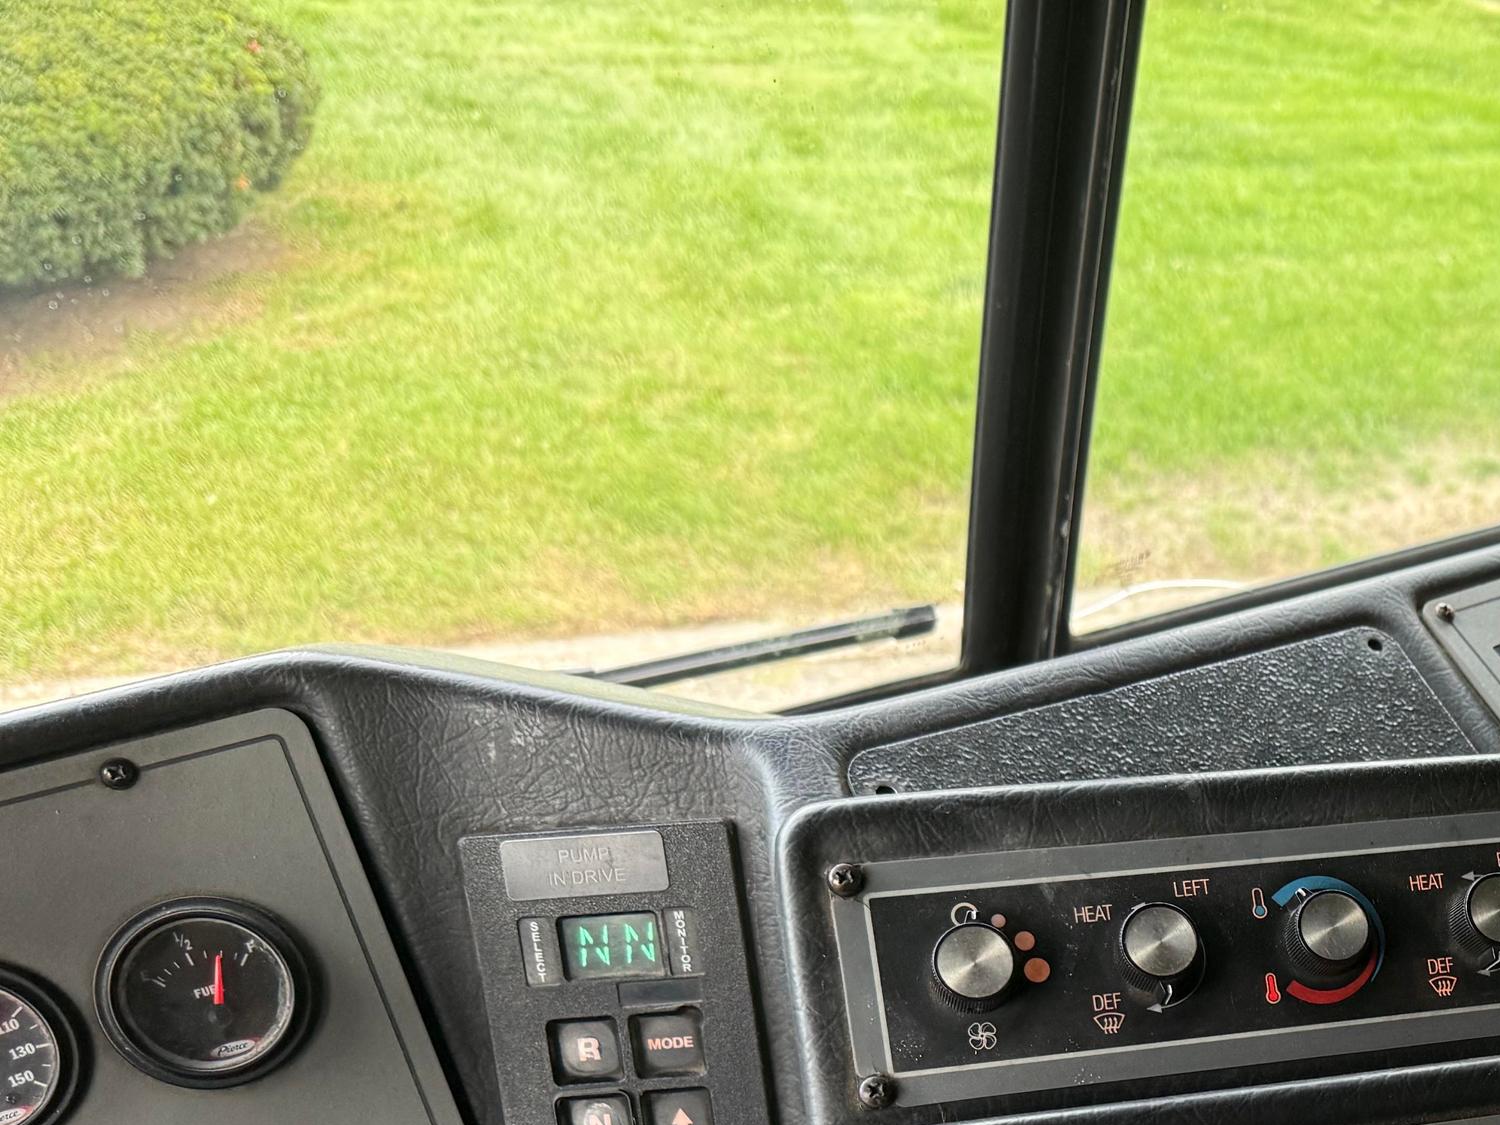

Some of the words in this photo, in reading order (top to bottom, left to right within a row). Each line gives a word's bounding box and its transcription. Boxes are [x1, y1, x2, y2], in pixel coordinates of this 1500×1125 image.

[557, 847, 609, 863] PUMP
[548, 871, 567, 886] IN
[571, 867, 626, 885] DRIVE
[1408, 873, 1445, 891] HEAT
[1173, 877, 1210, 898] LEFT
[1073, 904, 1113, 924] HEAT
[673, 910, 693, 973] MONITOR
[529, 920, 548, 984] SELECT
[1427, 957, 1454, 976] DEF
[193, 984, 225, 999] FUE
[1092, 994, 1122, 1012] DEF
[0, 1018, 20, 1035] 10
[8, 1042, 36, 1060] 130
[217, 1042, 248, 1057] Pierce
[576, 1037, 602, 1063] R
[648, 1036, 695, 1052] MODE
[8, 1070, 35, 1088] 150
